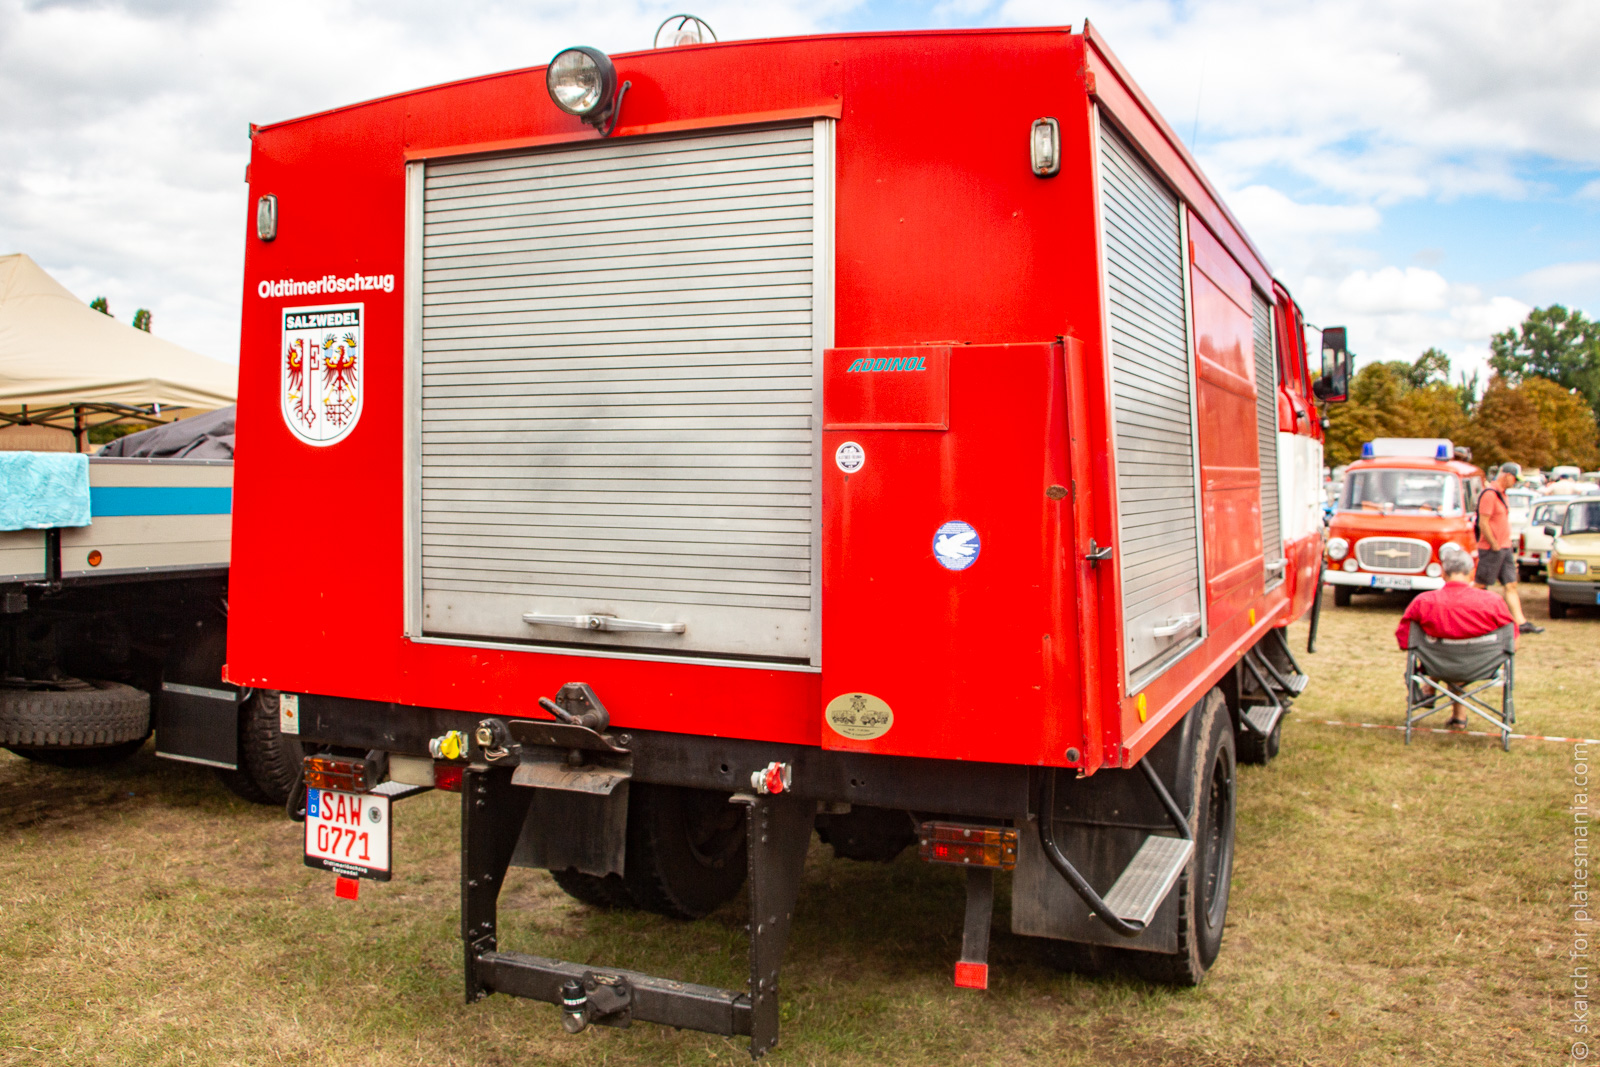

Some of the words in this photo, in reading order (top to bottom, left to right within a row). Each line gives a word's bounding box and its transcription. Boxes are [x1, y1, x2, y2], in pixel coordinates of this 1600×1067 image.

[258, 273, 395, 299] Oldtimerlöschzug
[286, 312, 359, 329] SALZWEDEL
[847, 356, 927, 372] ADDINOL
[311, 804, 317, 813] D
[321, 792, 362, 826] SAW
[317, 824, 370, 861] 0771
